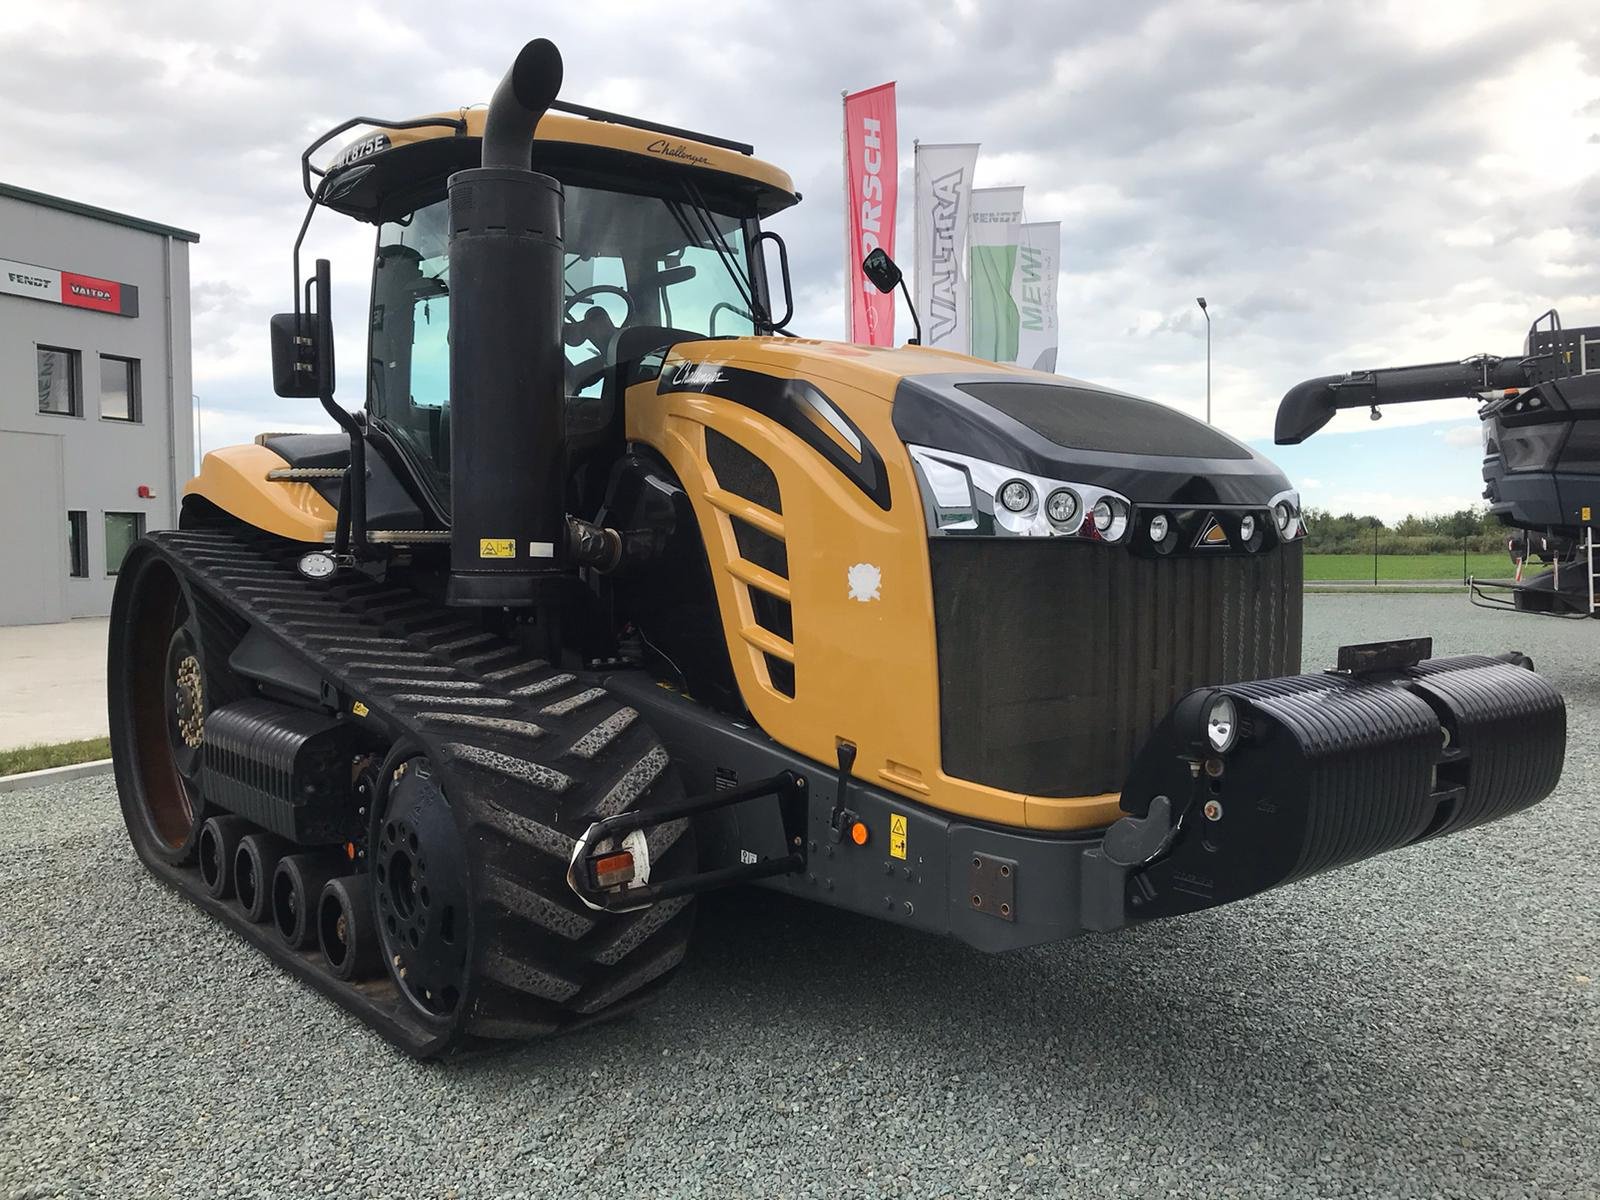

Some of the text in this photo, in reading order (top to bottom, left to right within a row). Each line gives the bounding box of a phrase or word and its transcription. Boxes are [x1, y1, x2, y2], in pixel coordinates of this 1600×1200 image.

[646, 139, 718, 166] Challenger
[930, 167, 964, 345] VALTRA
[8, 272, 52, 289] FENDT
[70, 284, 112, 302] VALTRA
